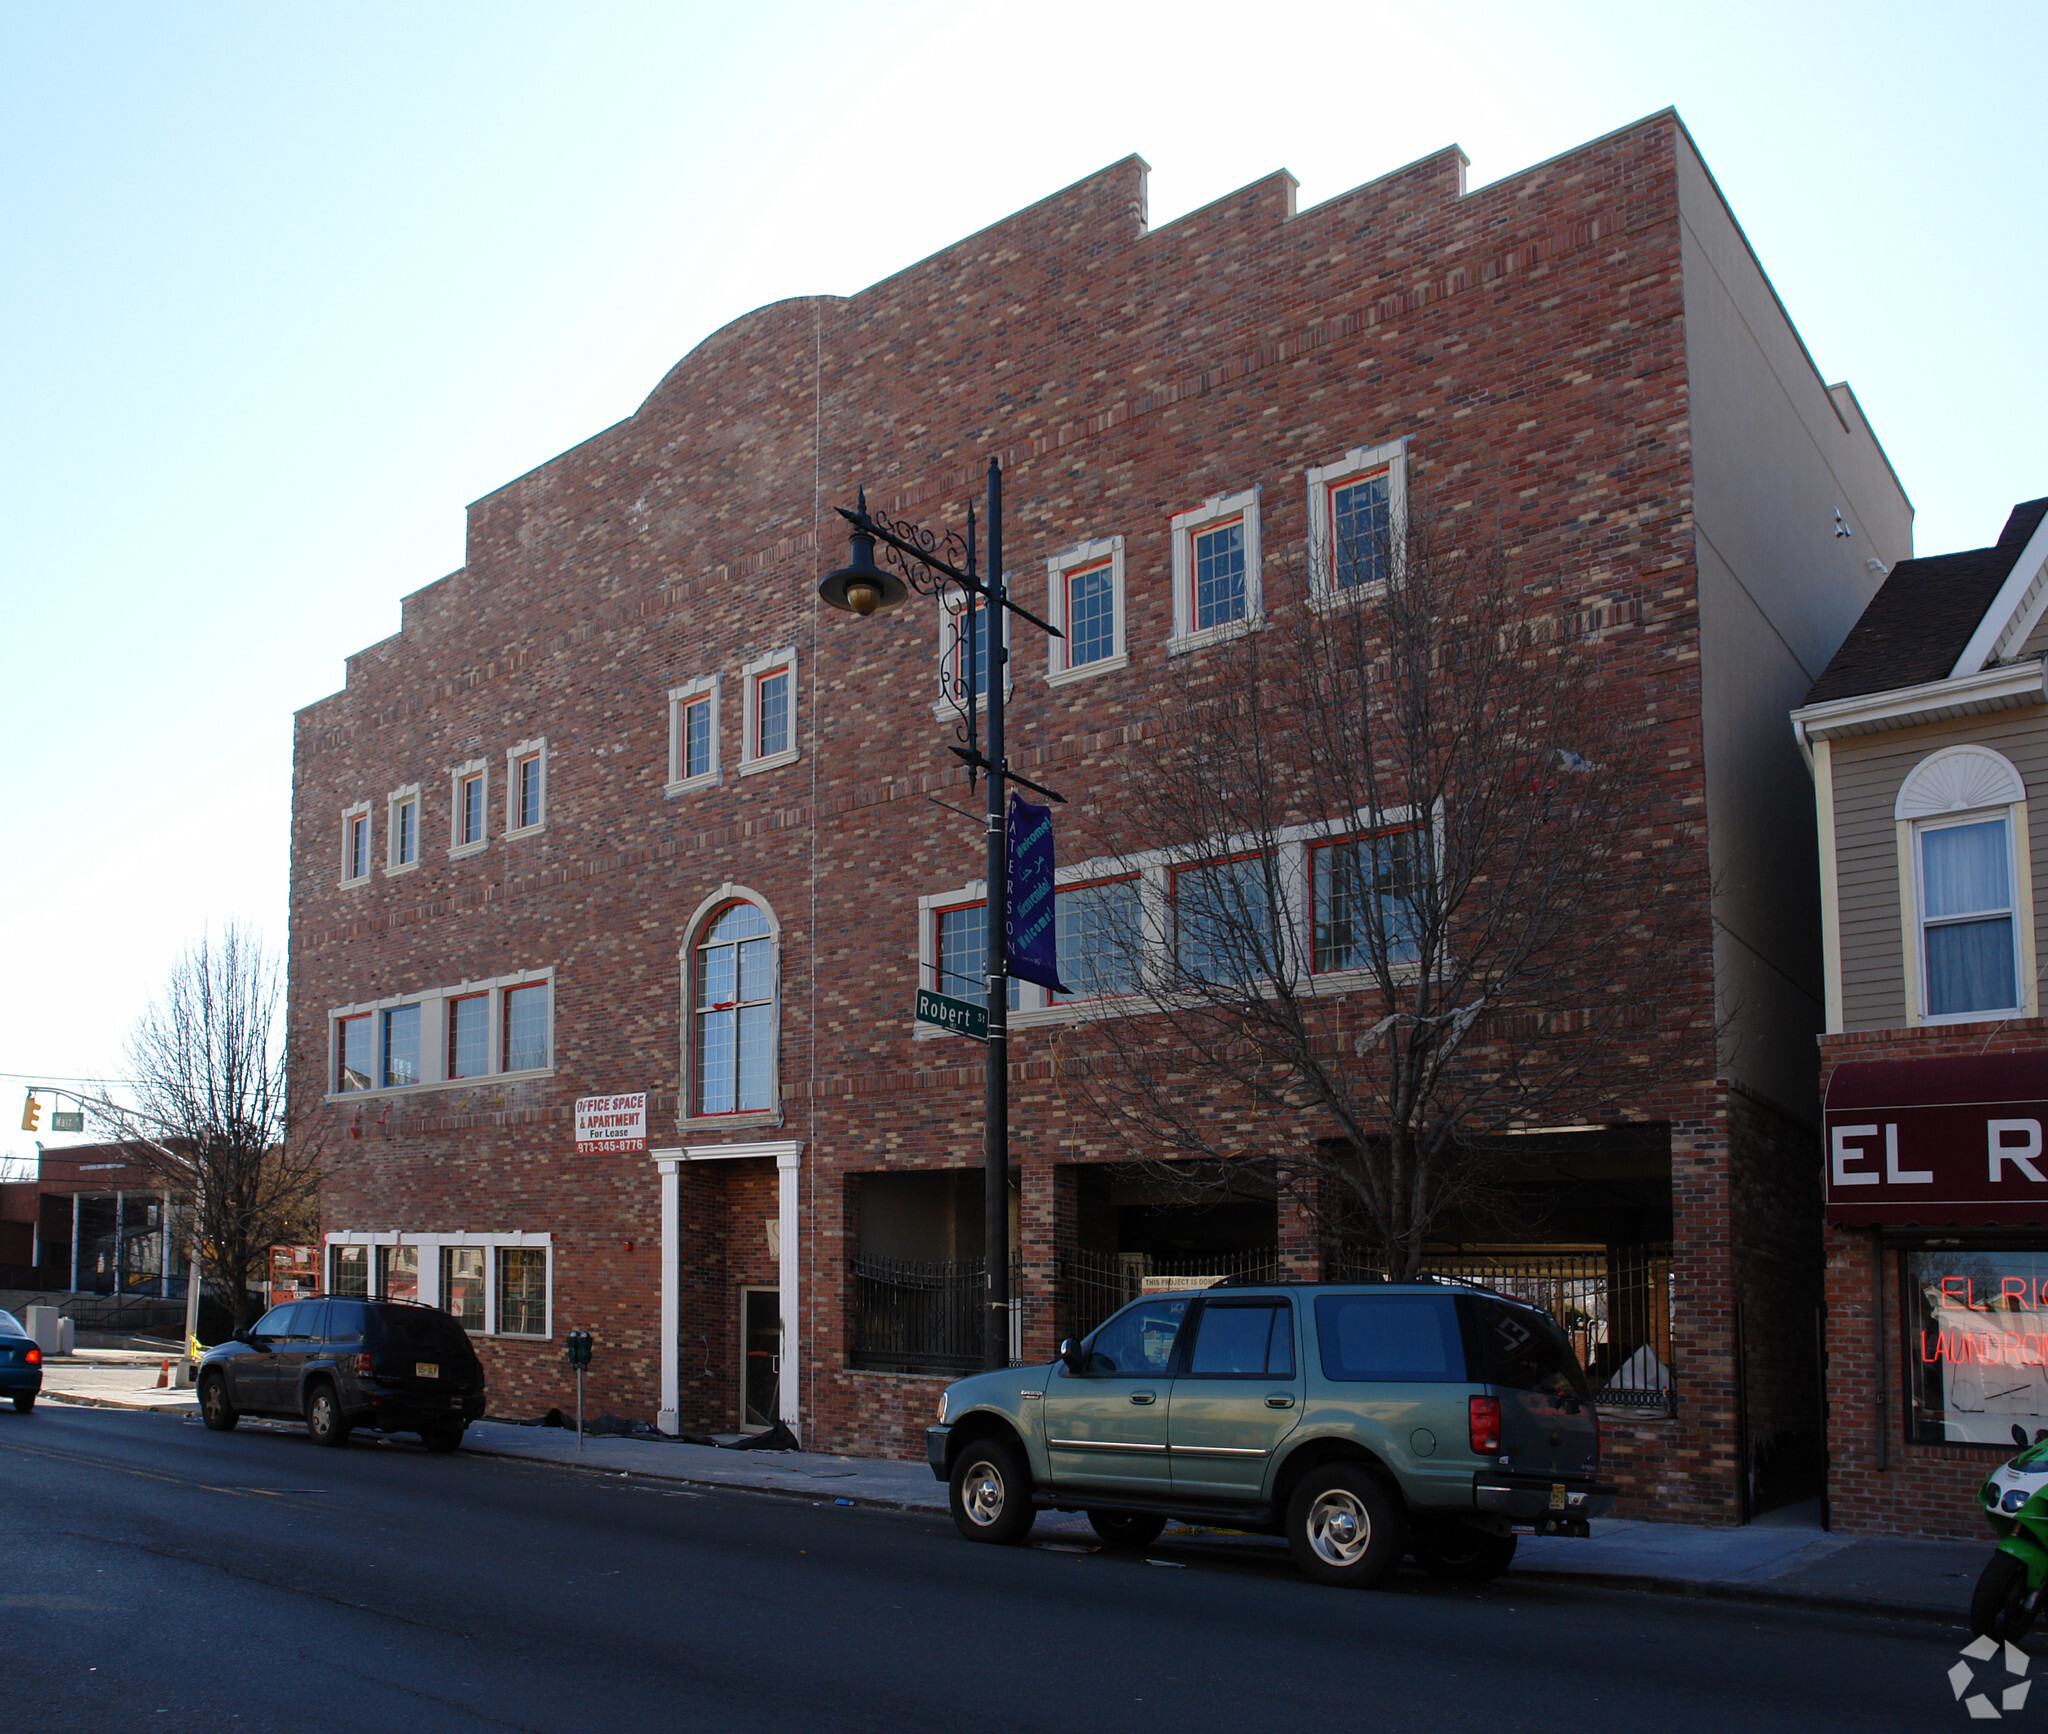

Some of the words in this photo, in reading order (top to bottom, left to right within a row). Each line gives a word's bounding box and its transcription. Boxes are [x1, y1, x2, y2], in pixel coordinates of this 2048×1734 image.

[1016, 816, 1052, 858] Welcome!
[1006, 800, 1017, 955] PATERSON
[1017, 906, 1054, 950] Welcome!
[920, 996, 970, 1027] Robert
[977, 1012, 985, 1024] St
[577, 1098, 611, 1113] OFFICE
[612, 1095, 644, 1110] SPACE
[580, 1116, 586, 1129] &
[587, 1112, 640, 1129] APARTMENT
[590, 1129, 603, 1139] For
[605, 1129, 629, 1138] Lease
[577, 1139, 643, 1153] 973-345-8776
[1831, 1123, 1934, 1186] EL
[1191, 1277, 1198, 1285] IS
[1941, 1276, 1989, 1310] EL
